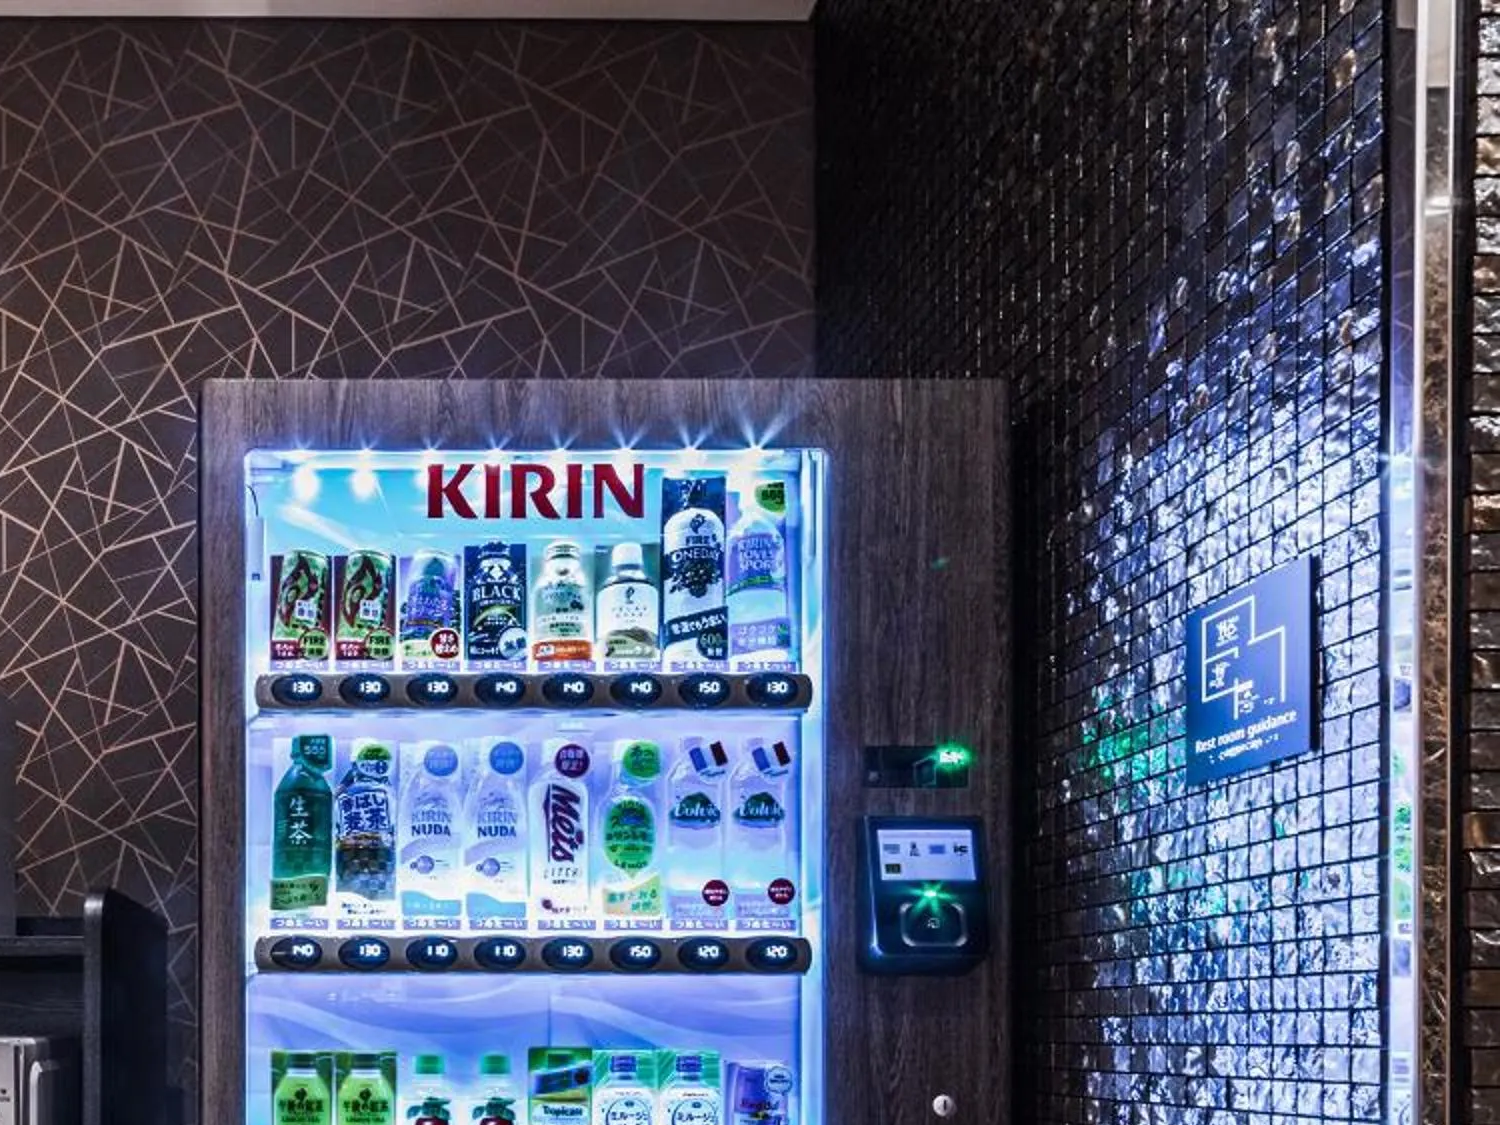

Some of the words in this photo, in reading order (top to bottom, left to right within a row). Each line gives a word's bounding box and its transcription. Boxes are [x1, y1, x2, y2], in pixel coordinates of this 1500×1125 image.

[426, 462, 646, 520] KIRIN
[472, 585, 521, 601] BLACK
[292, 681, 314, 693] 130
[360, 681, 382, 693] 130
[427, 681, 449, 693] 130
[699, 681, 720, 693] 150
[766, 681, 788, 693] 130
[1247, 710, 1297, 739] guidance
[288, 796, 313, 840] 生茶
[411, 810, 452, 823] KIRIN
[477, 811, 518, 824] KIRIN
[551, 784, 584, 863] Mets
[411, 824, 451, 837] NUDA
[477, 825, 517, 838] NUDA
[359, 945, 381, 957] 130
[427, 945, 449, 957] 110
[495, 945, 516, 957] 110
[563, 945, 584, 957] 130
[629, 945, 651, 957] 150
[698, 945, 719, 957] 120
[765, 945, 787, 957] 120
